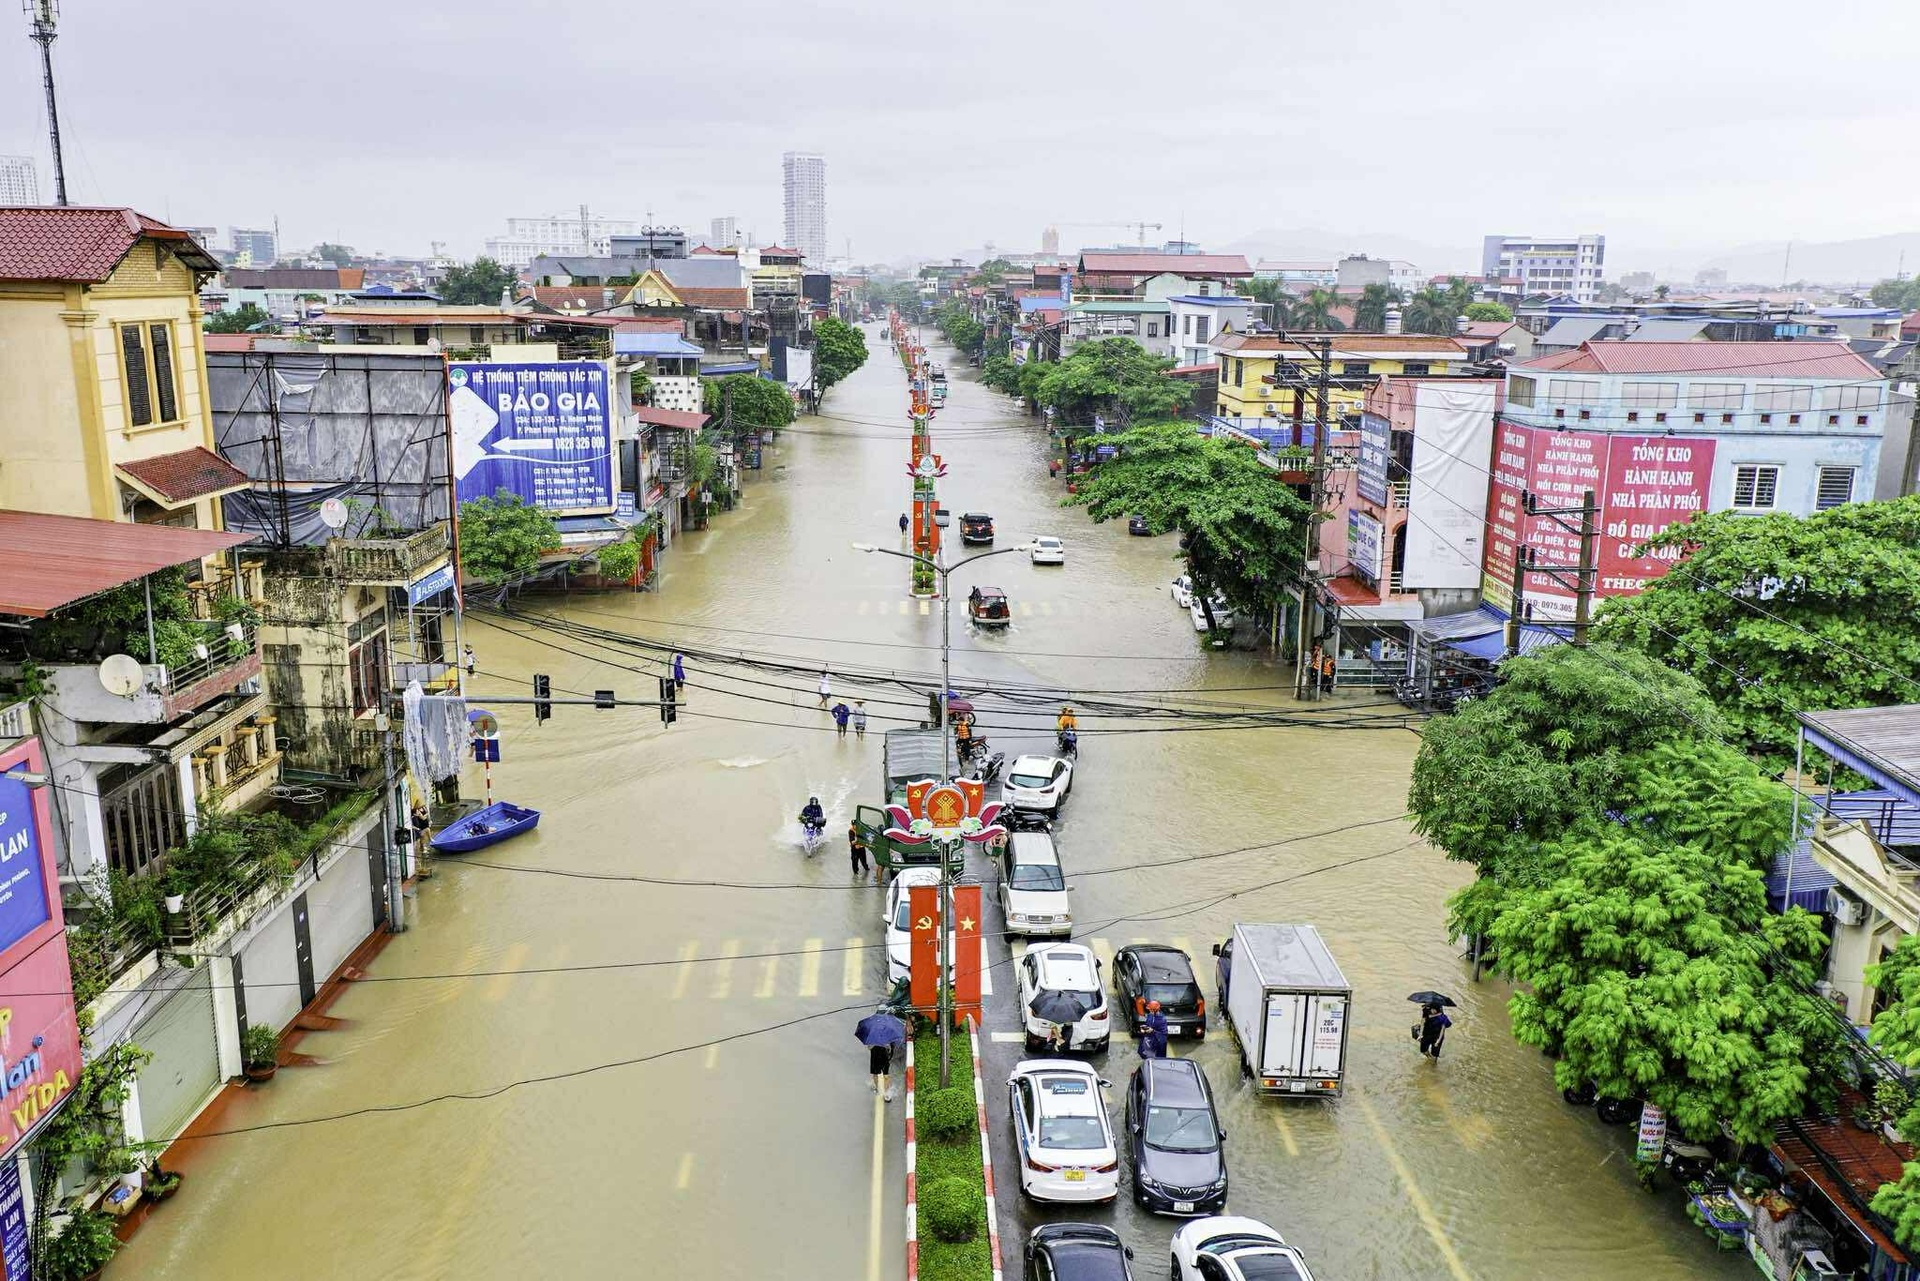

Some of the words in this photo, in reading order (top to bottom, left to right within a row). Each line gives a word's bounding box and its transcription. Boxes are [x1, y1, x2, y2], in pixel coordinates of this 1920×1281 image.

[472, 371, 484, 385] HỆ
[486, 369, 514, 383] THỐNG
[516, 369, 537, 383] TIÊM
[539, 368, 567, 382] CHỦNG
[588, 371, 602, 382] XIN
[499, 386, 550, 412] BẢO
[557, 392, 600, 411] GIA
[555, 437, 575, 450] 0828
[576, 437, 590, 449] 326
[592, 436, 605, 449] 000
[1550, 432, 1573, 447] TỔNG
[1573, 437, 1592, 449] KHO
[1545, 448, 1569, 460] HÀNH
[1570, 452, 1594, 465] HẠNH
[1632, 439, 1664, 461] TỔNG
[1666, 447, 1692, 462] KHO
[1536, 462, 1554, 474] NHÀ
[1556, 463, 1578, 476] PHÂN
[1580, 465, 1600, 480] PHỐI
[1624, 466, 1657, 485] HÀNH
[1659, 471, 1694, 490] HẠNH
[1536, 478, 1551, 490] NỒI
[1553, 482, 1572, 493] CƠM
[1611, 490, 1636, 508] NHÀ
[1638, 490, 1671, 509] PHÂN
[1673, 489, 1701, 510] PHỐI
[1607, 518, 1627, 538] ĐỒ
[1630, 523, 1654, 539] GIA
[1549, 549, 1567, 561] GAS,
[1531, 573, 1548, 585] CÁC
[1, 828, 28, 863] LAN
[0, 1185, 21, 1217] THANH
[5, 1208, 20, 1231] LAN
